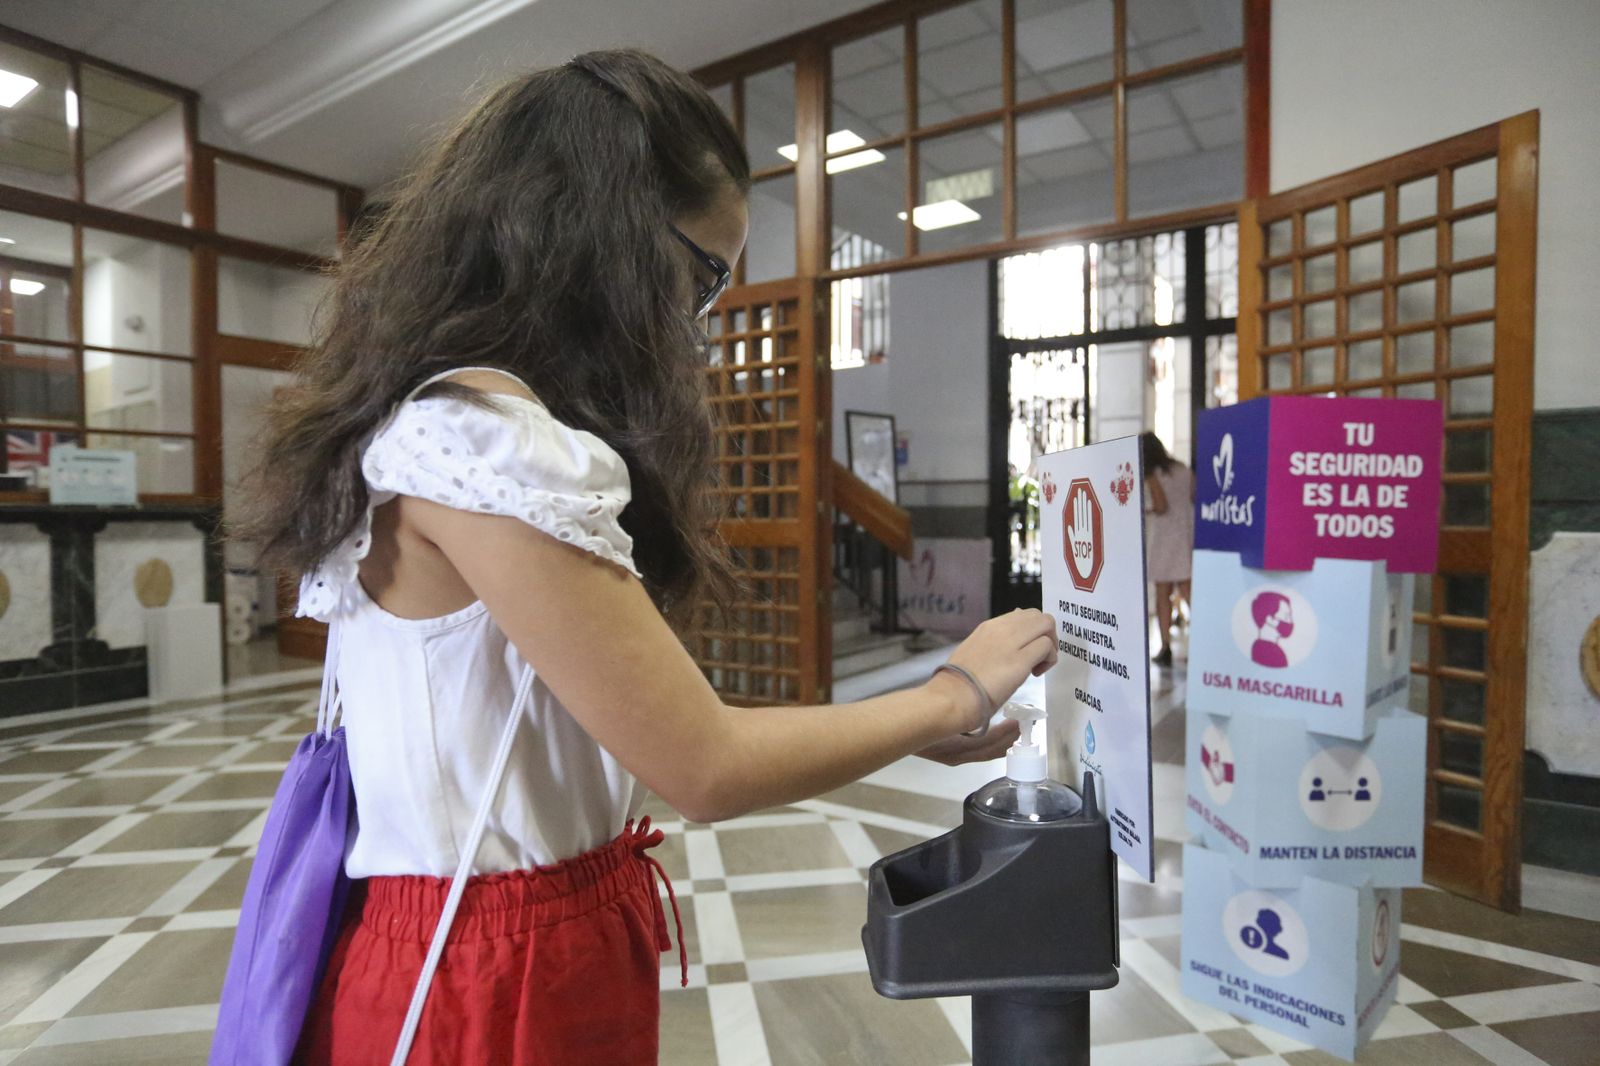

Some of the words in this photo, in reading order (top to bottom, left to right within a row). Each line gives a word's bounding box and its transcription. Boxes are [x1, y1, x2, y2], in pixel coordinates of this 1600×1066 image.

[1343, 422, 1375, 446] TU
[1289, 451, 1424, 478] SEGURIDAD
[1302, 483, 1333, 507] ES
[1340, 484, 1372, 508] LA
[1377, 485, 1409, 509] DE
[1313, 513, 1395, 539] TODOS
[1074, 541, 1092, 559] STOP
[1059, 600, 1069, 612] POR
[1071, 603, 1079, 616] TU
[1080, 606, 1119, 631] SEGURIDAD,
[1062, 621, 1074, 635] POR
[1074, 625, 1082, 637] LA
[1058, 640, 1088, 662] GIENIZATE
[1088, 651, 1101, 668] LAS
[1074, 687, 1103, 713] GRACIAS.
[1203, 672, 1232, 690] USA
[1237, 677, 1344, 708] MASCARILLA
[1259, 847, 1318, 860] MANTEN
[1322, 847, 1340, 860] LA
[1344, 846, 1417, 860] DISTANCIA
[1190, 960, 1223, 981] SIGUE
[1226, 974, 1249, 990] LAS
[1253, 983, 1346, 1027] INDICACIONES
[1218, 985, 1240, 1002] DEL
[1244, 995, 1310, 1029] PERSONAL
